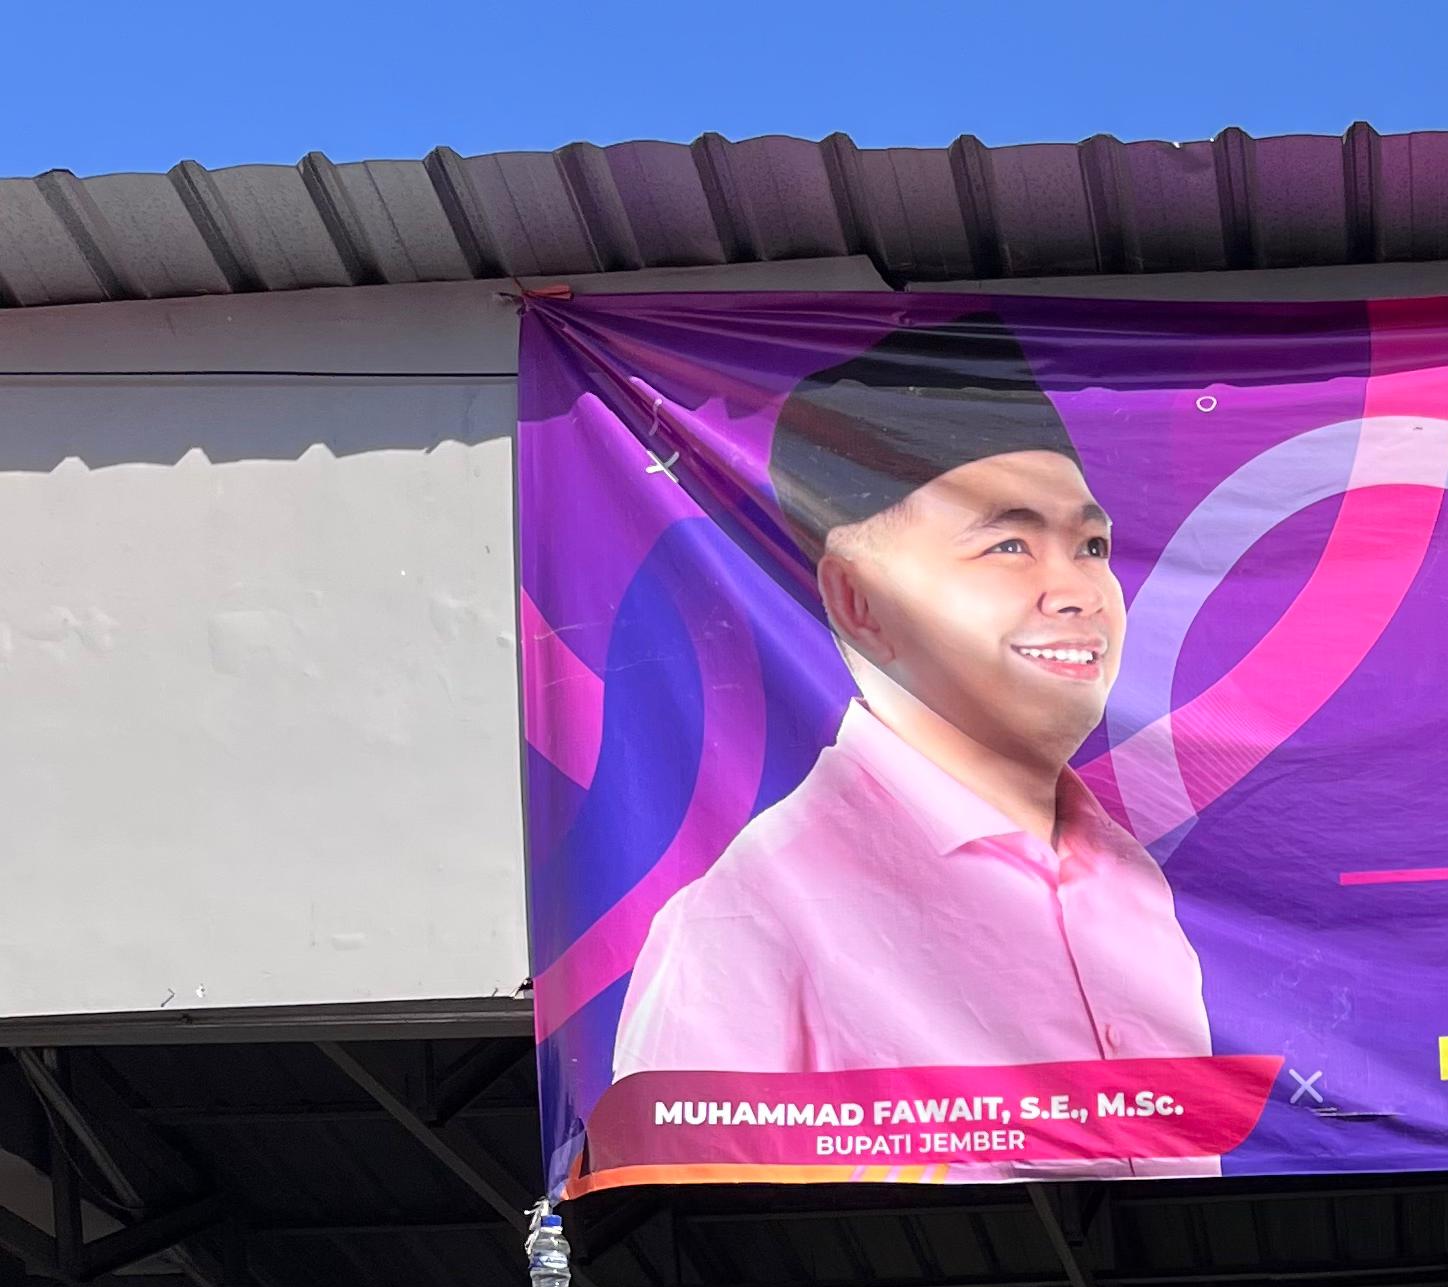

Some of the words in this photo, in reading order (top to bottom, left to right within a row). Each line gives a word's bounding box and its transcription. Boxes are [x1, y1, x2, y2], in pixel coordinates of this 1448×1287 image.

[654, 1101, 862, 1126] MUHAMMAD
[873, 1096, 1010, 1124] FAWAIT,
[1019, 1093, 1089, 1122] S.E.,
[1096, 1090, 1185, 1117] M.Sc.
[815, 1132, 911, 1156] BUPATI
[917, 1129, 1026, 1154] JEMBER
